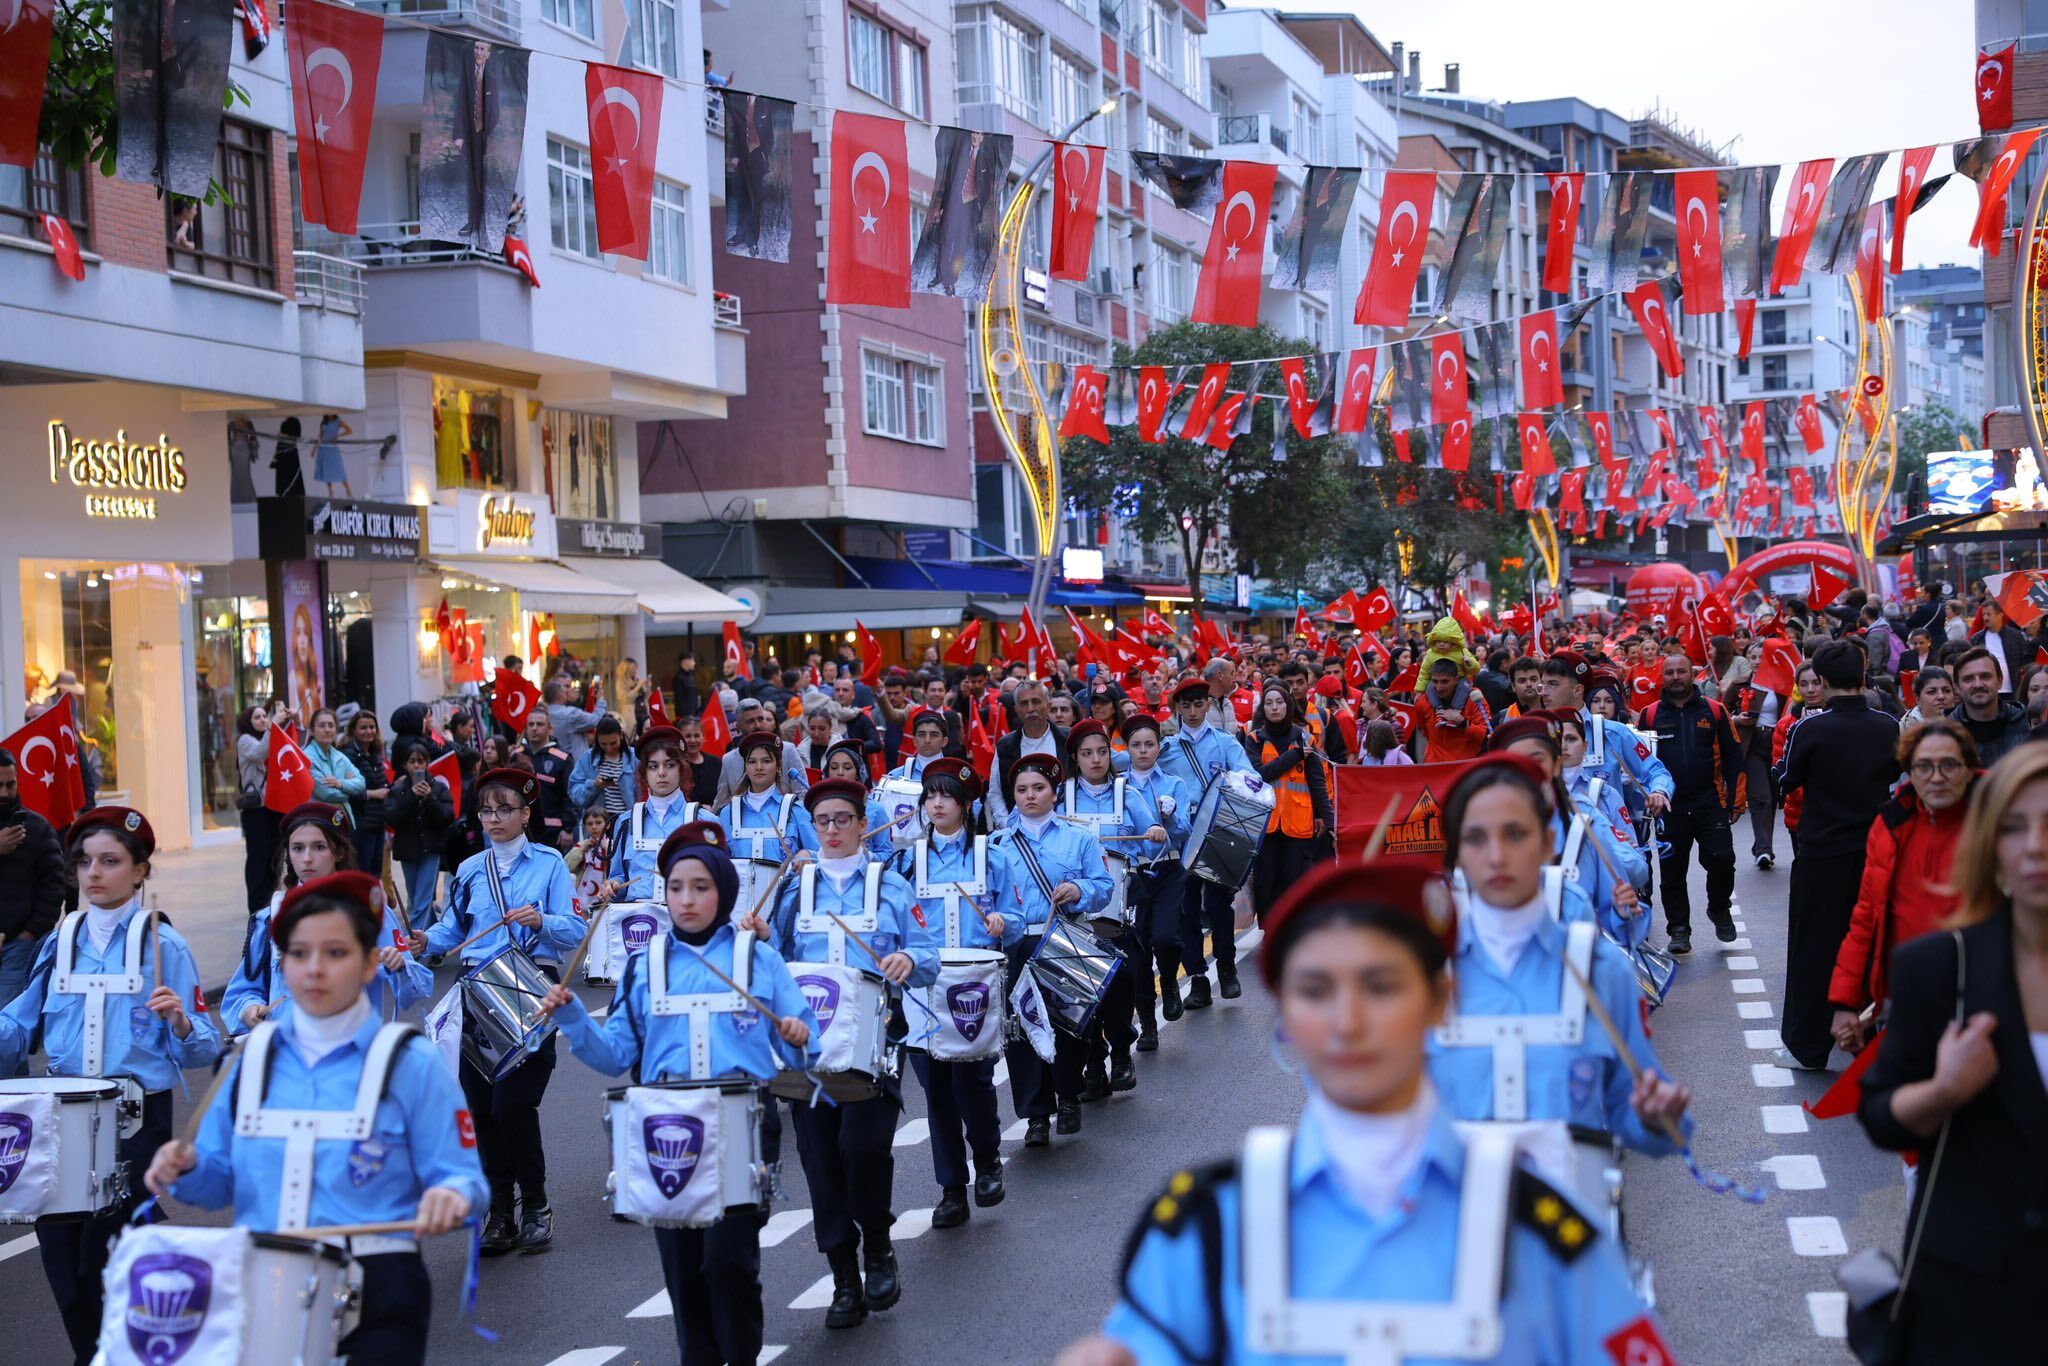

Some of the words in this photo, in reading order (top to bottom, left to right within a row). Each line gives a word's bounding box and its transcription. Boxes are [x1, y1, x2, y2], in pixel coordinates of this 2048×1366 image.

[48, 419, 187, 493] Passionis
[331, 504, 364, 536] KUAFÖR
[366, 512, 391, 538] KIRIK
[393, 515, 420, 540] MAKAS
[1385, 820, 1425, 843] MAG
